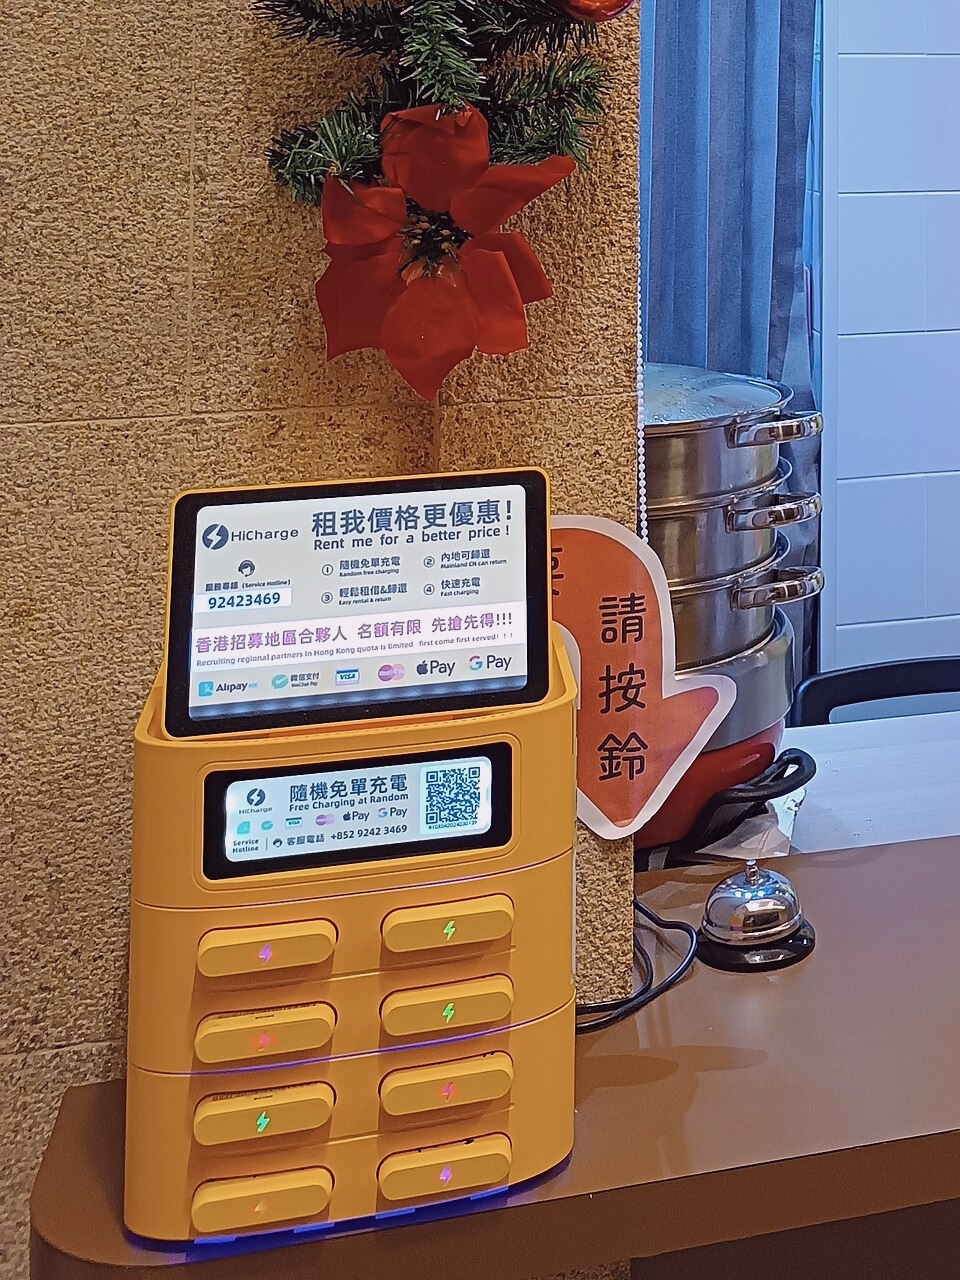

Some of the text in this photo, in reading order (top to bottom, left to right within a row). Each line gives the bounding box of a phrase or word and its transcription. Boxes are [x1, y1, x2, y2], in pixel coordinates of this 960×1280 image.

[231, 529, 299, 541] HiCharge
[314, 539, 344, 551] Rent
[352, 537, 373, 548] me
[380, 534, 399, 546] for
[406, 535, 415, 544] a
[422, 529, 461, 542] better
[441, 577, 480, 589] 快速充電
[208, 592, 280, 609] 92423469
[196, 626, 347, 653] 香港招募地區合夥人
[357, 619, 421, 639] 名額有限
[196, 657, 235, 667] Recruiting
[237, 654, 269, 664] regional
[271, 651, 303, 662] partners
[313, 648, 334, 657] Hong
[336, 647, 355, 656] Kong
[357, 644, 378, 653] quota
[388, 641, 413, 650] limited
[486, 654, 512, 671] Pay
[430, 660, 456, 676] Pay
[597, 593, 648, 781] 請按鈴
[289, 774, 408, 803] 隨機免單充電
[289, 803, 310, 811] Free
[313, 798, 355, 809] Charging
[370, 793, 409, 803] Random
[352, 811, 370, 822] Pay
[390, 807, 408, 817] Pay
[287, 824, 408, 845] 客服電話 +852 9242 3469
